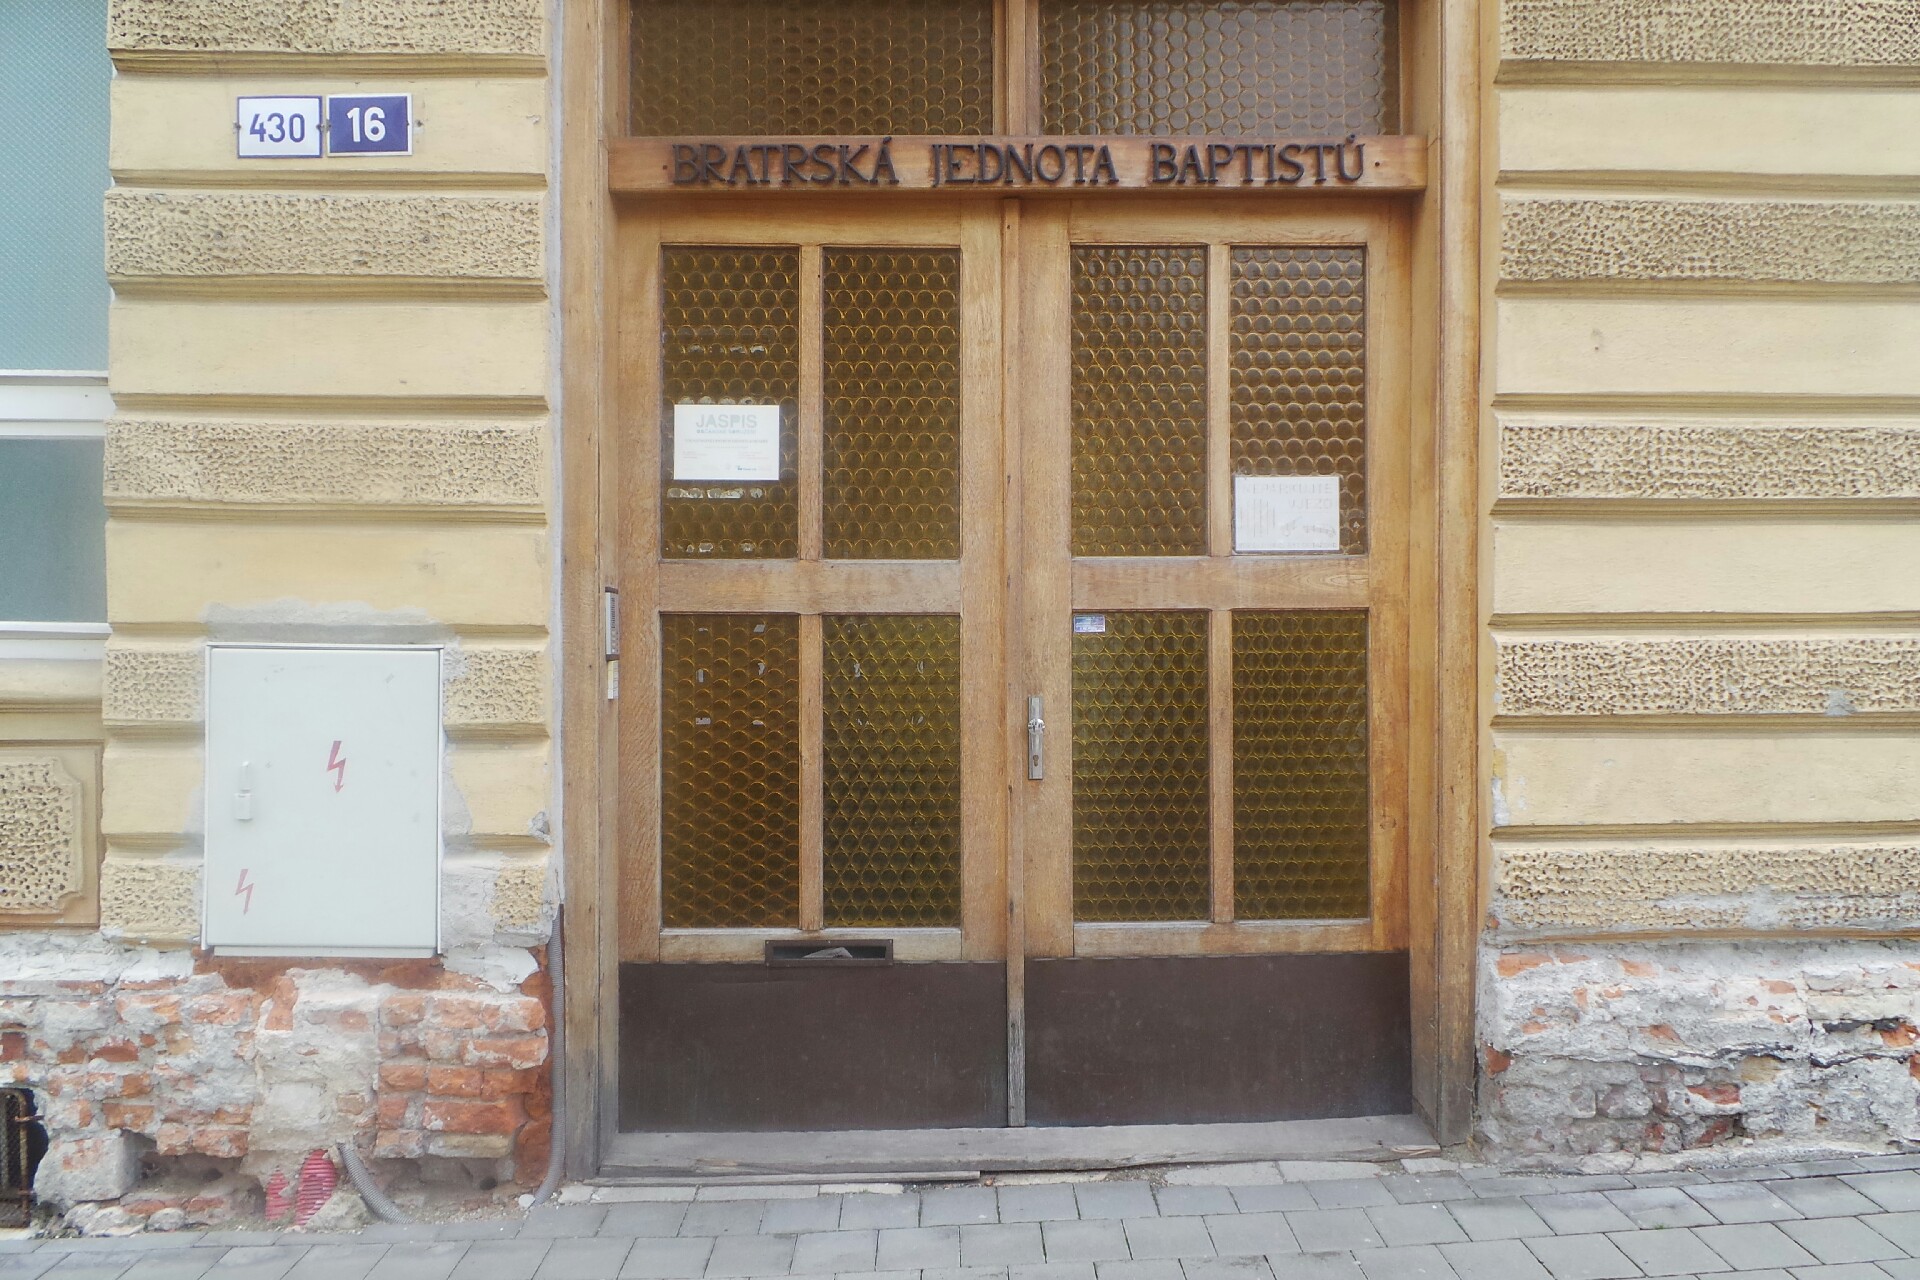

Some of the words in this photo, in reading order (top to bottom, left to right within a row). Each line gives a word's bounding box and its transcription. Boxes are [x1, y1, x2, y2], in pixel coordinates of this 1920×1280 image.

[250, 112, 306, 143] 430
[346, 106, 386, 143] 16
[672, 136, 900, 184] BRATRSKÁ
[931, 143, 1120, 187] JEDNOTA
[696, 413, 758, 429] JASPIS
